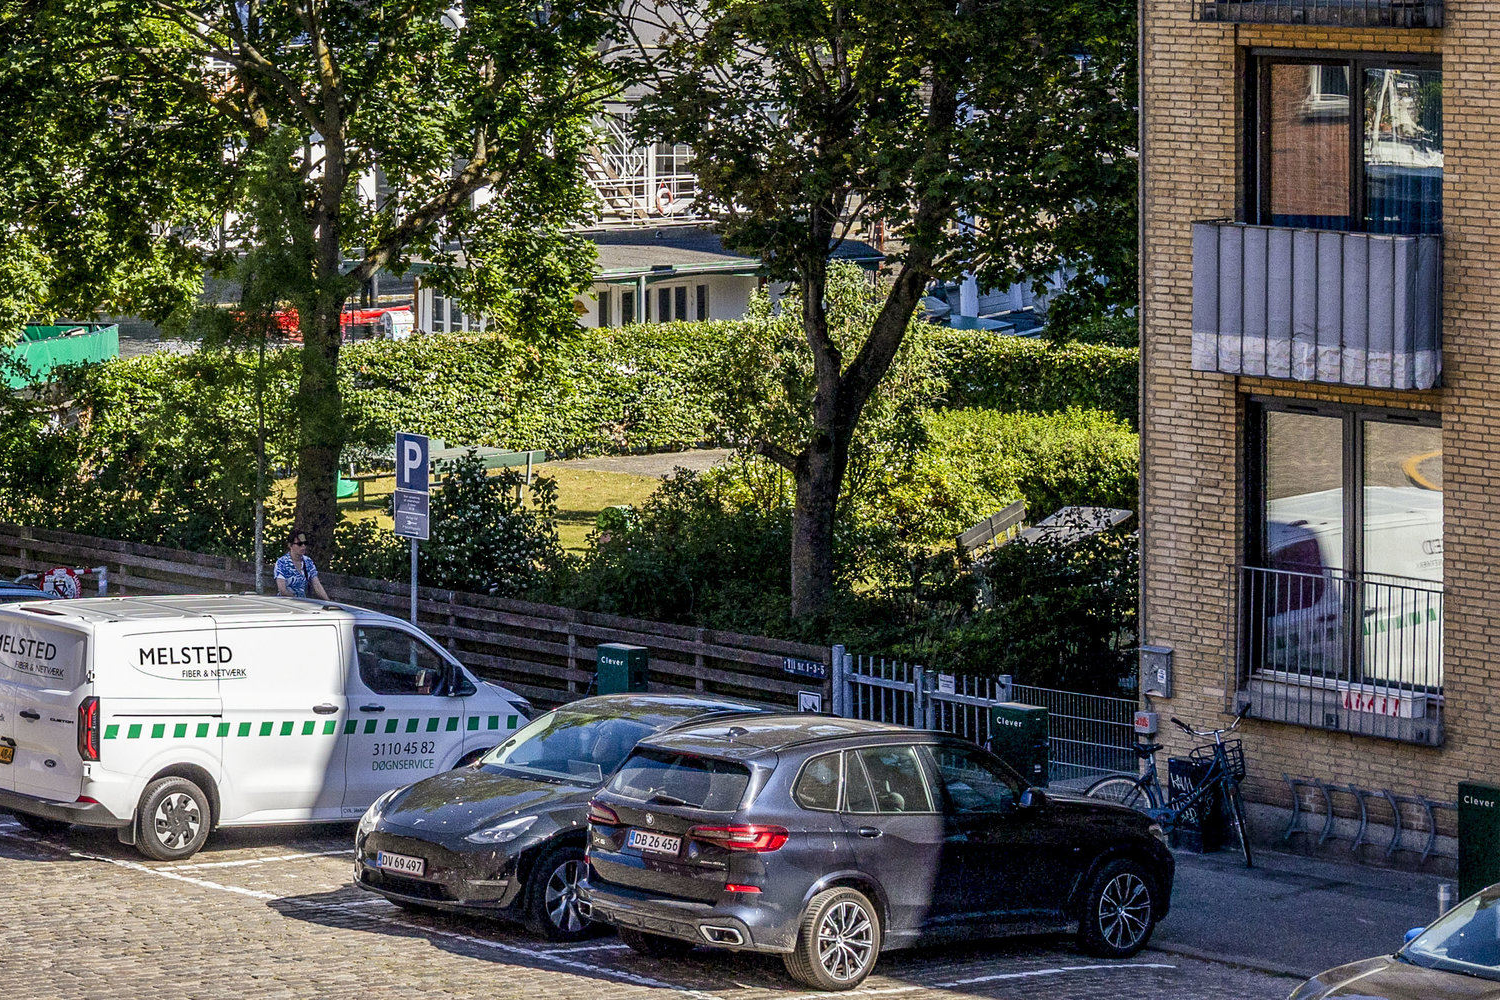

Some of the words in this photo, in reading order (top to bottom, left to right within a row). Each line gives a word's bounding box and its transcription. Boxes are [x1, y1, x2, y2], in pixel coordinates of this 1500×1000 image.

[404, 440, 422, 483] P
[139, 646, 233, 666] MELSTED
[601, 656, 624, 667] Clever
[14, 661, 29, 671] FIBER
[30, 663, 34, 671] &
[35, 664, 65, 677] NETVÆRK
[182, 669, 202, 678] FIBER
[211, 668, 247, 677] NETVÆRK
[996, 716, 1022, 728] Clever
[372, 742, 401, 756] 3110
[403, 742, 418, 754] 45
[420, 741, 435, 754] 82
[372, 759, 435, 771] DØGNSERVICE
[1463, 795, 1495, 808] Clever
[634, 833, 646, 845] DB
[649, 836, 660, 848] 26
[661, 838, 678, 852] 456
[382, 855, 393, 866] DV
[394, 857, 404, 869] 69
[406, 860, 422, 872] 497
